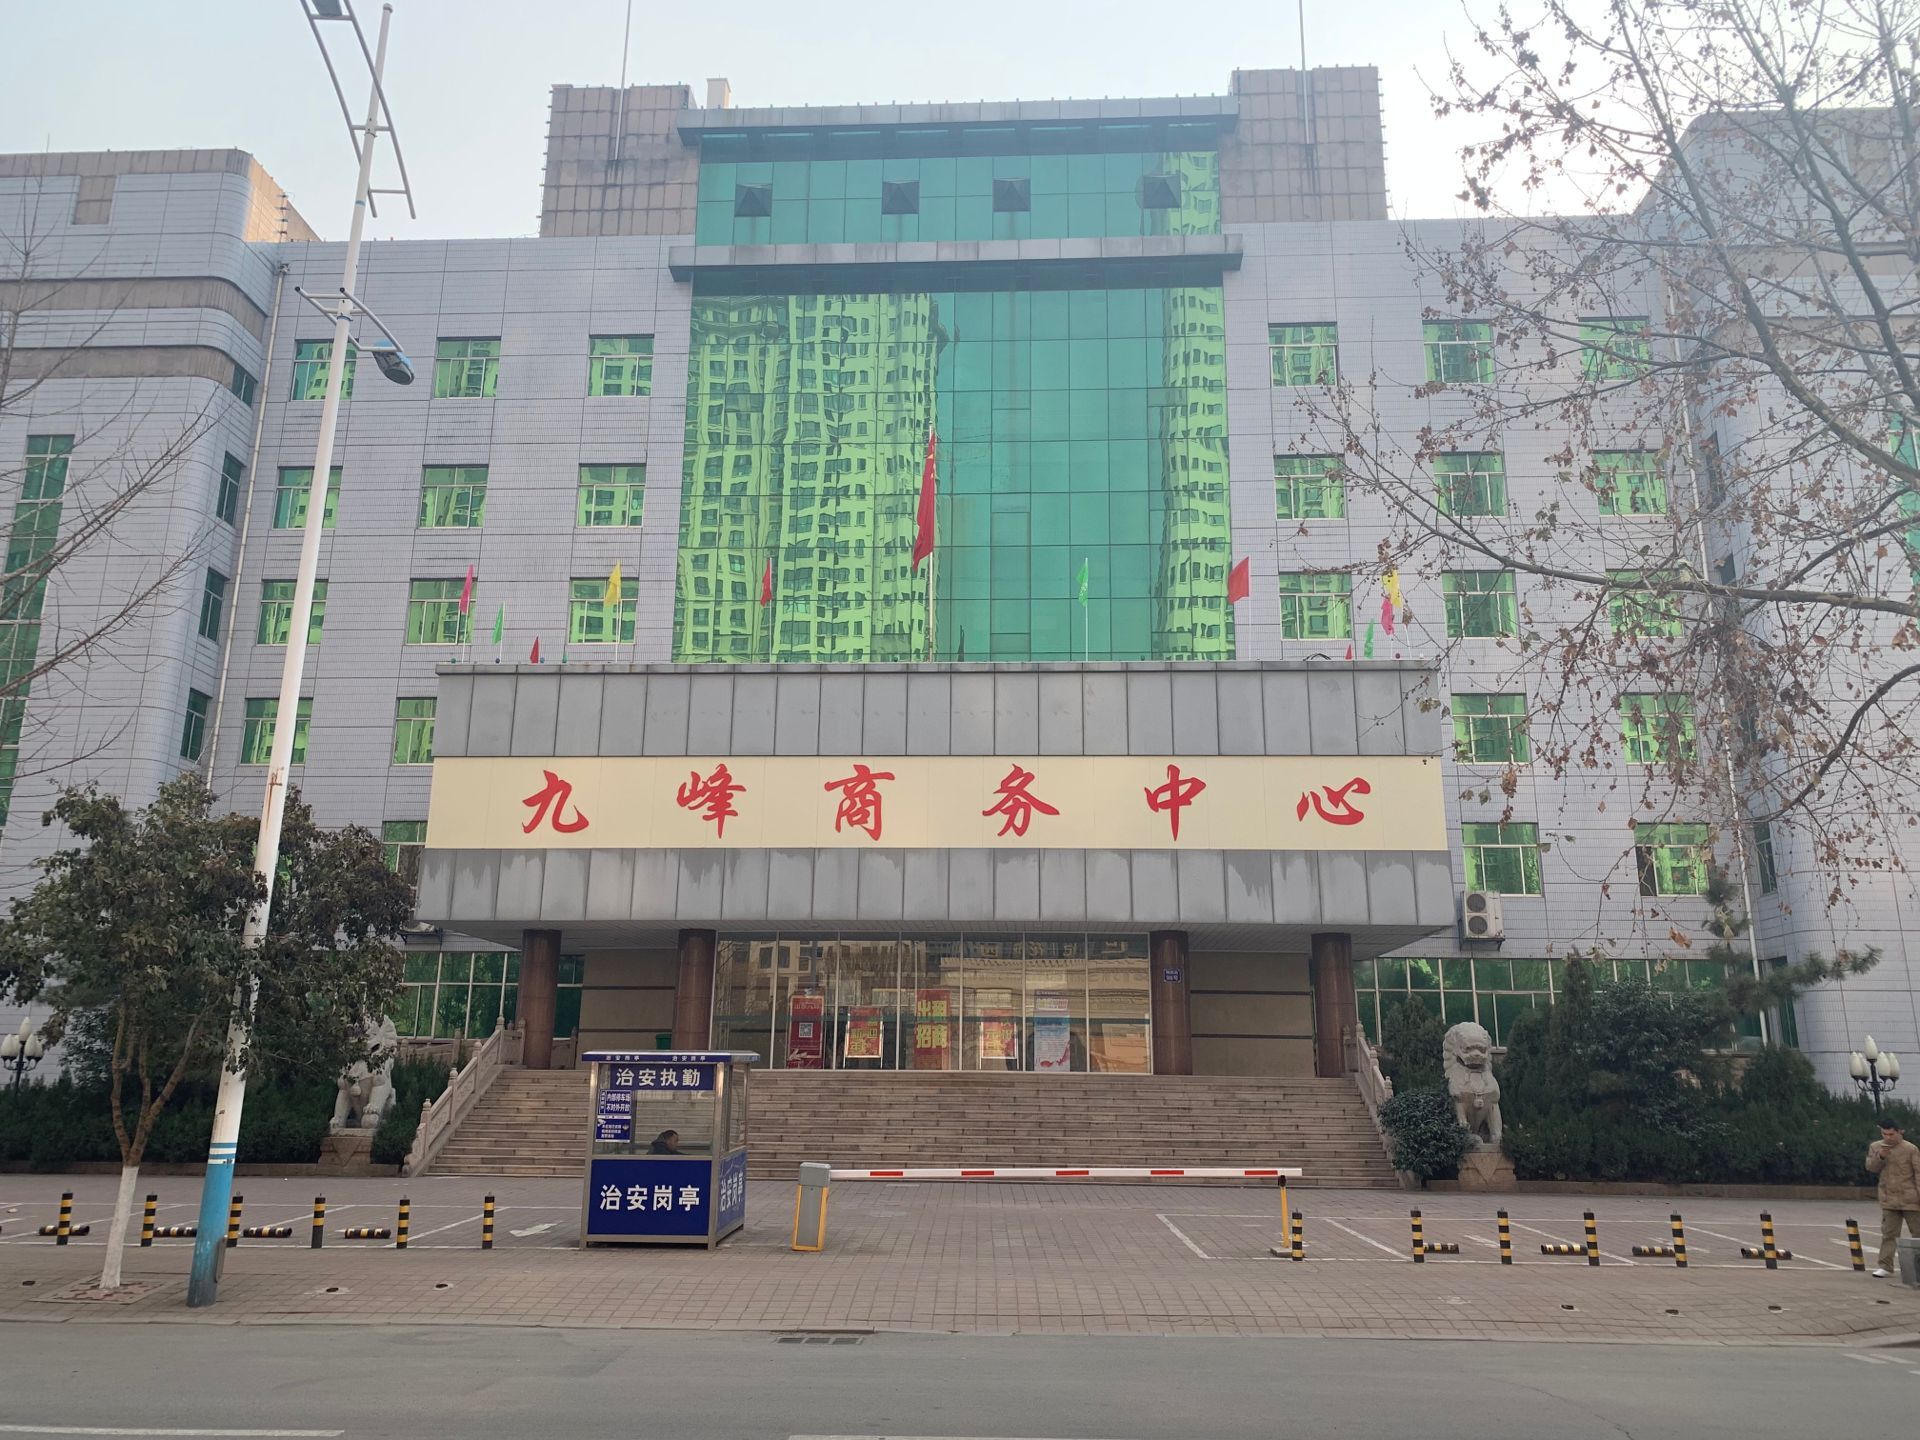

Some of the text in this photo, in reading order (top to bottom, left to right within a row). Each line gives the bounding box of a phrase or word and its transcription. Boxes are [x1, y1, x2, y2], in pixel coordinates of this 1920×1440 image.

[523, 764, 1371, 841] 九峰商务中心
[916, 1024, 948, 1048] 招商
[616, 1068, 700, 1087] 治安执勤
[606, 1093, 631, 1102] 内部停车场
[606, 1103, 631, 1112] 不对外开放
[600, 1184, 700, 1211] 治安岗亭
[720, 1171, 743, 1212] 治安岗亭
